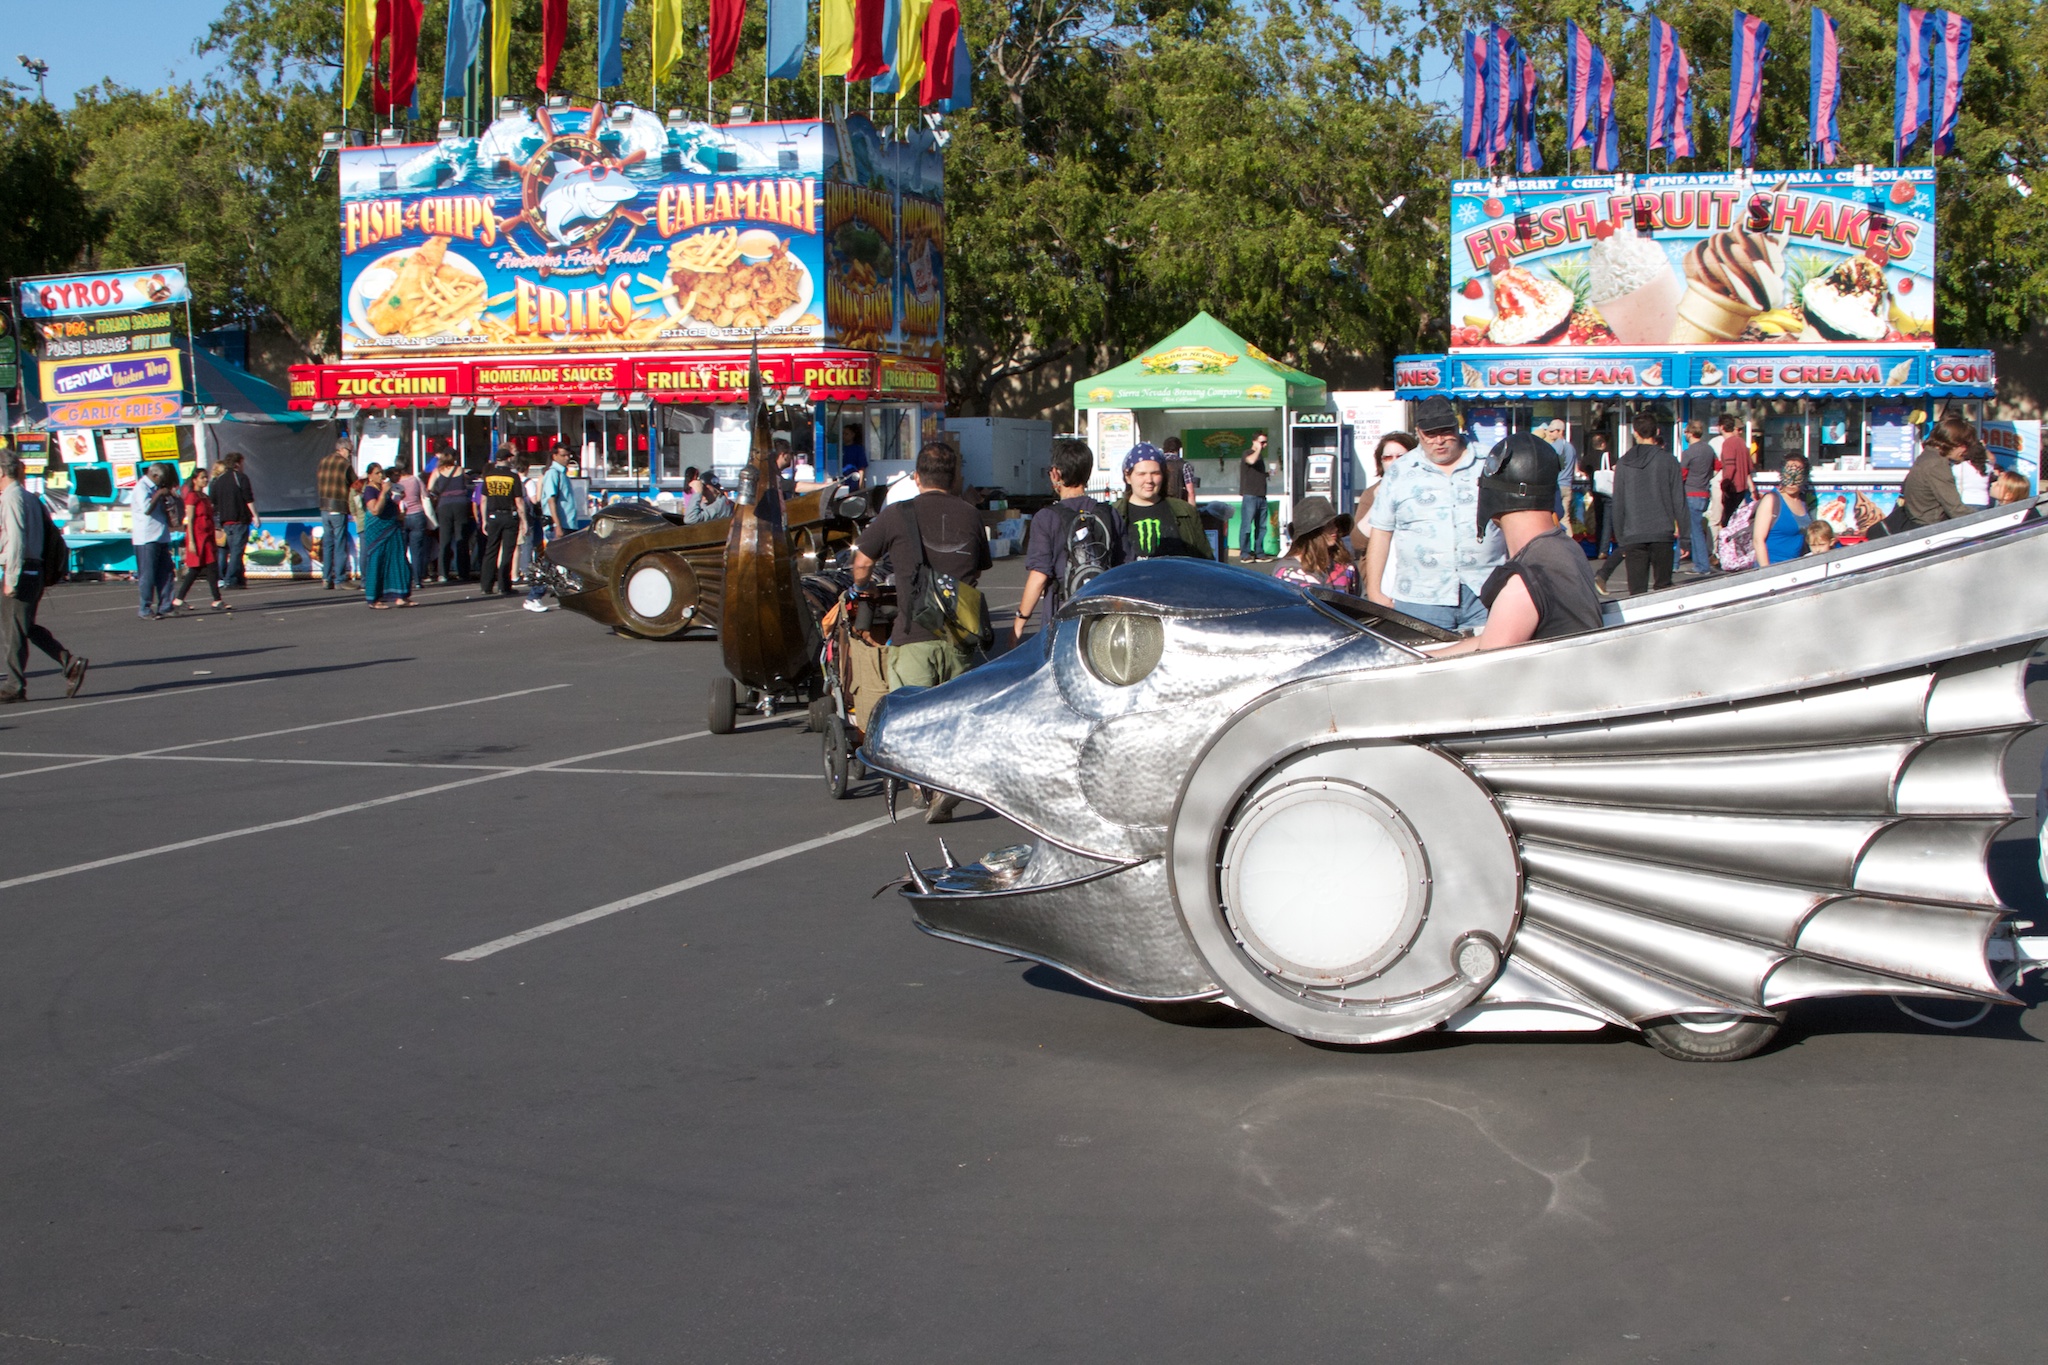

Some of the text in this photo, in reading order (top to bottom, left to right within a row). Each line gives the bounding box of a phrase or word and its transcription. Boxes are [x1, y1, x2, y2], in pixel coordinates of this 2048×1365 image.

[1453, 180, 1558, 192] STRABERRY
[1751, 172, 1824, 184] BANANA
[1835, 170, 1934, 182] CHCOLATE
[656, 177, 816, 238] CALAMARI
[345, 194, 496, 255] FISH & CHIPS
[1464, 188, 1920, 271] FRESH FRUIT SHAKES
[564, 248, 604, 267] Fried
[40, 278, 124, 310] GYROS
[514, 273, 632, 335] FRIES
[65, 321, 88, 337] DOG
[660, 328, 707, 338] RINGS
[710, 328, 720, 336] &
[82, 336, 128, 355] SAUSAGE
[131, 335, 150, 350] HOT
[354, 335, 489, 347] ALASKAN POLLOCK
[1190, 352, 1223, 362] NEVADA
[57, 361, 168, 392] TERIYAKI Chicken Wrap
[479, 367, 614, 384] HOMEMADE SAUCES
[648, 370, 774, 389] FRILLY FRIS
[804, 368, 871, 386] PICKLES
[885, 370, 936, 388] FRENCH FRIES
[1488, 366, 1635, 386] ICE CREAM
[1728, 365, 1881, 384] ICE CREAM
[337, 377, 446, 396] ZUCCHINI
[1117, 388, 1140, 398] Sierra
[1142, 387, 1171, 397] Nevada
[1173, 386, 1205, 398] Brewing
[1207, 386, 1243, 399] Company
[68, 402, 162, 422] GARLIC FRIES
[1298, 414, 1334, 423] ATM
[486, 482, 513, 490] EVENT
[488, 488, 511, 497] STAFF
